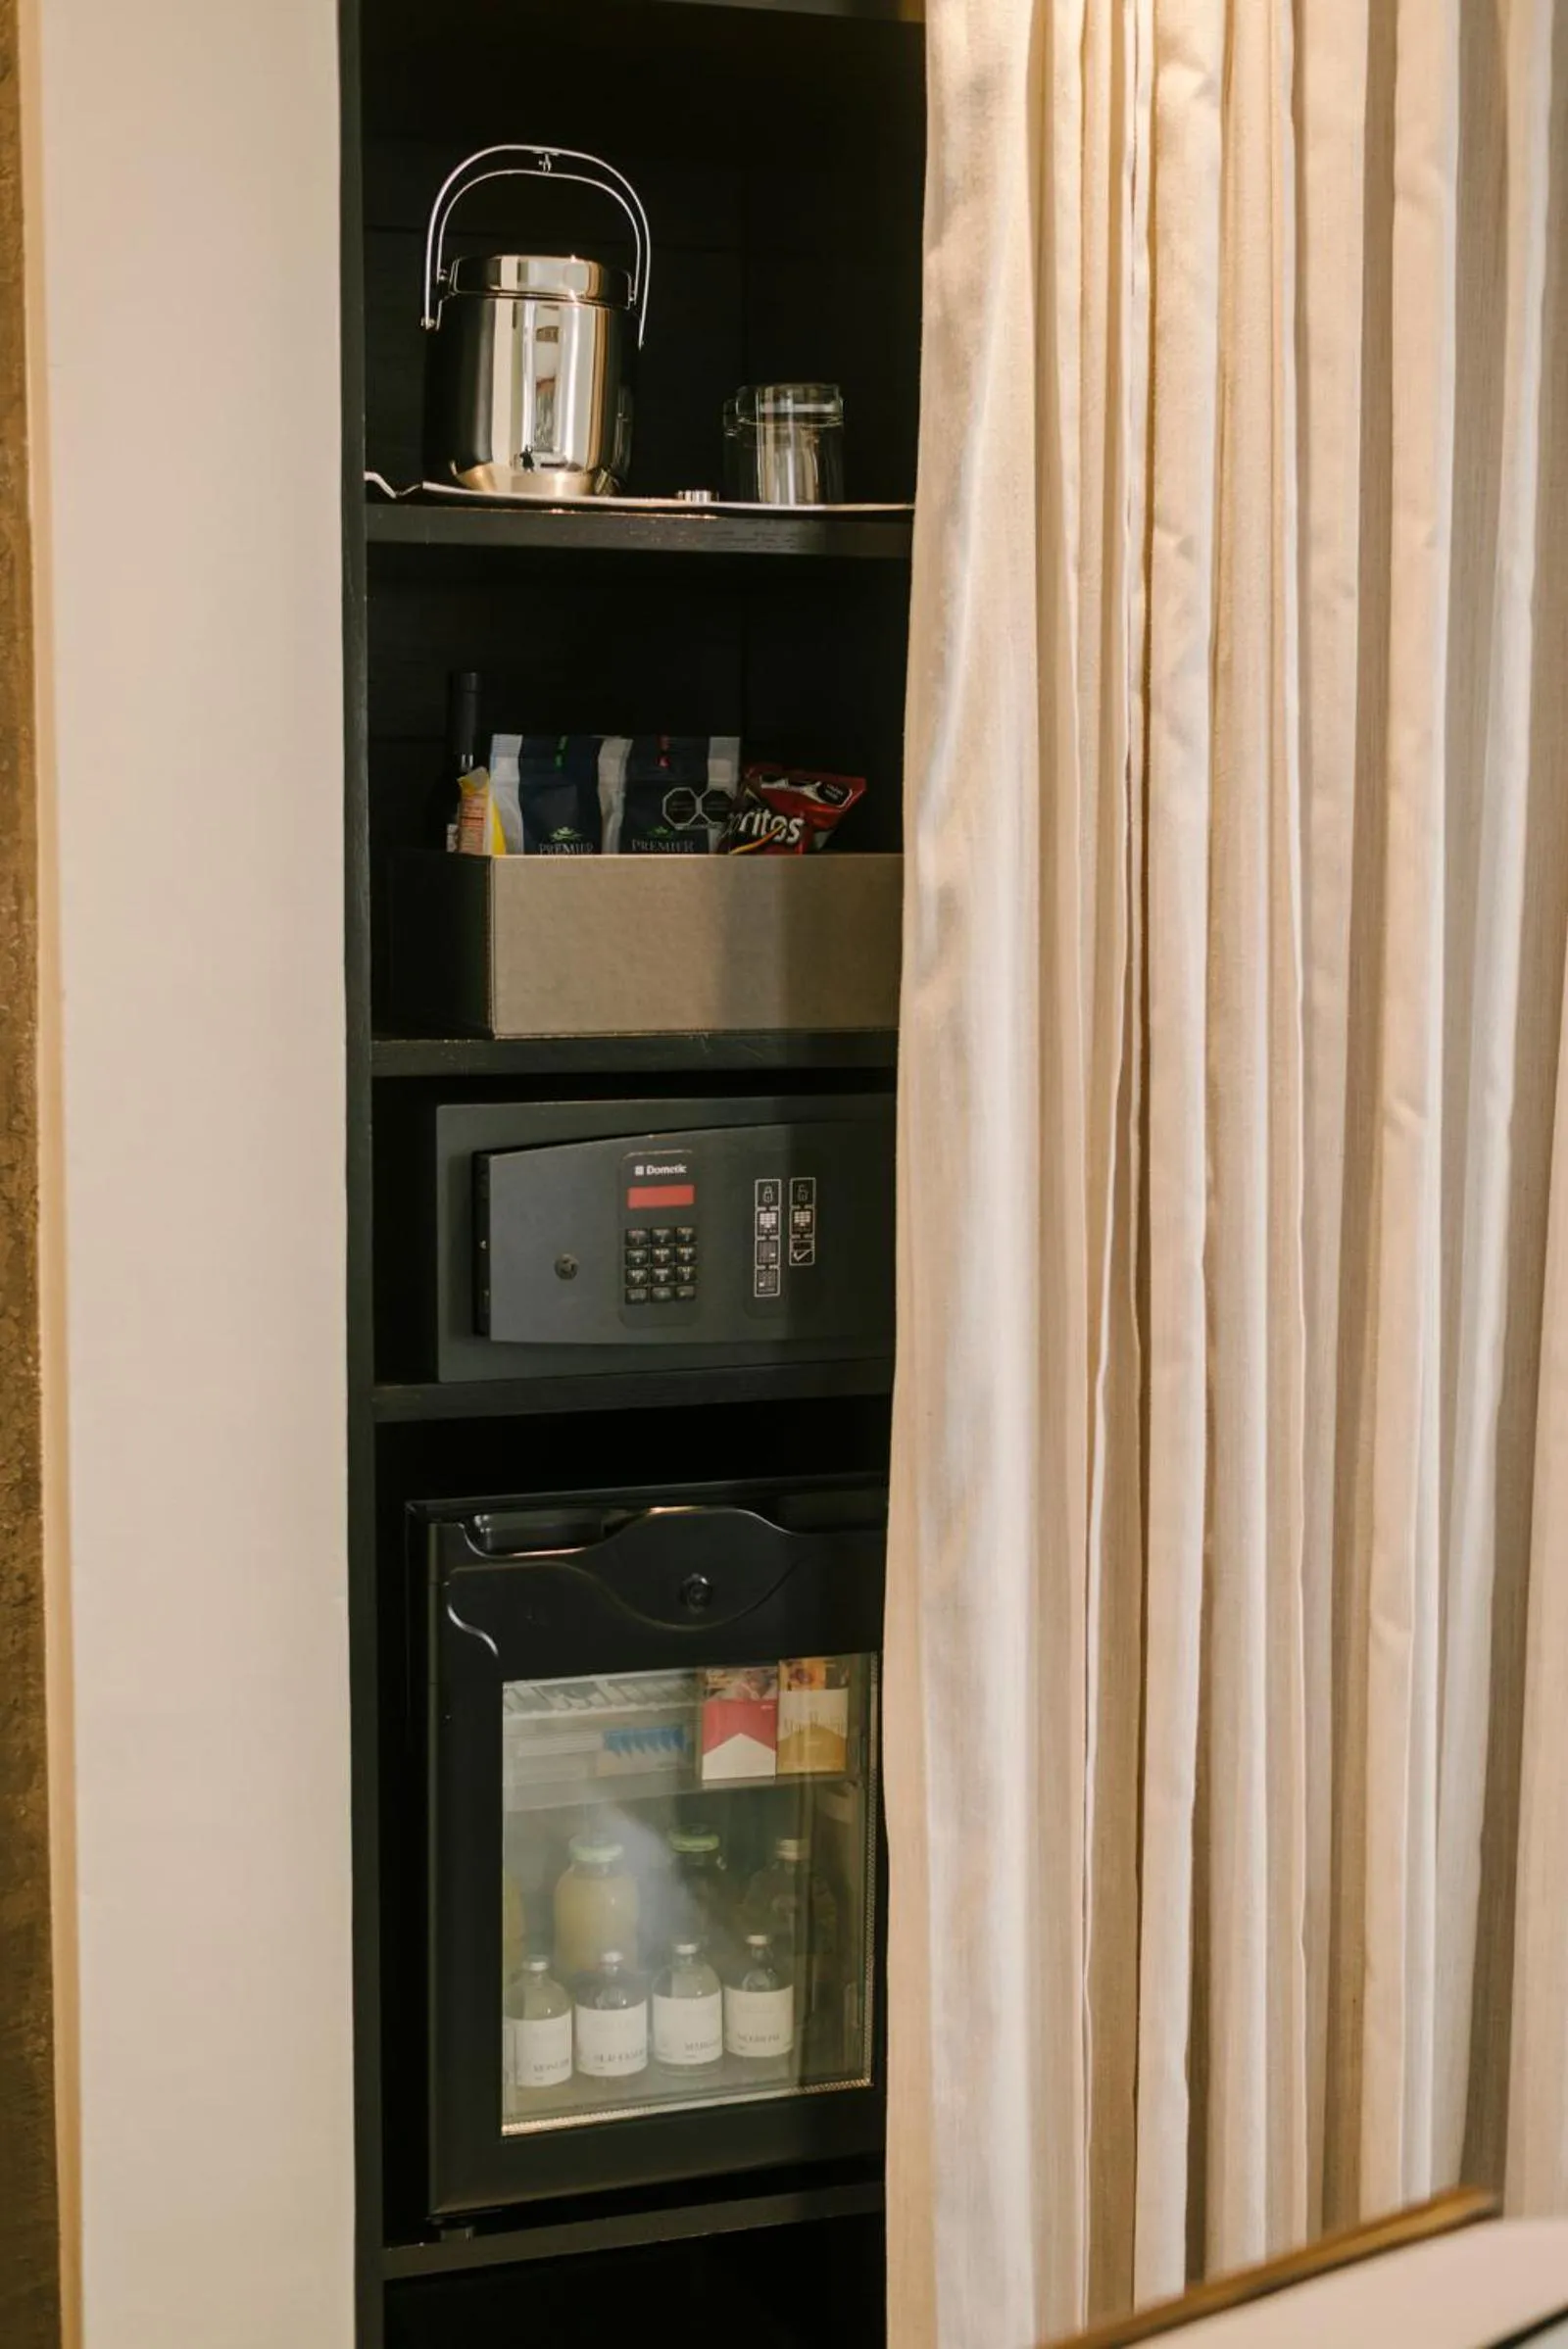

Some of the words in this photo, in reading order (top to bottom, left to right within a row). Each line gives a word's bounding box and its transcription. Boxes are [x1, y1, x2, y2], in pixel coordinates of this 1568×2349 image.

[729, 808, 805, 846] ritos
[631, 836, 695, 853] PREMIER
[646, 1163, 688, 1176] Dometic
